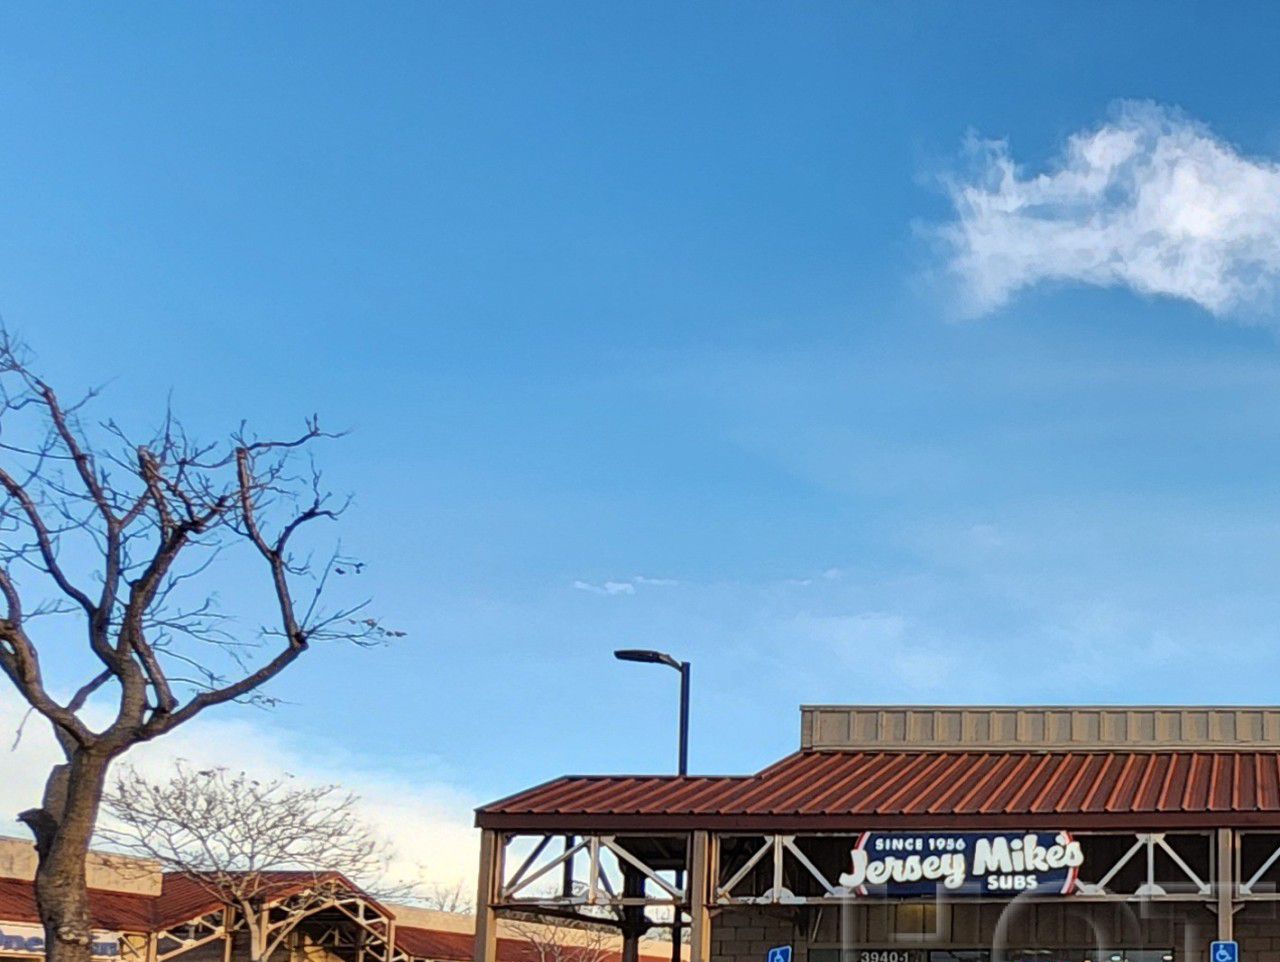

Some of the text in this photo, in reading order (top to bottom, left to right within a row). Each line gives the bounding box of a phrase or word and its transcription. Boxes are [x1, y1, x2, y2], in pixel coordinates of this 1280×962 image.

[874, 837, 966, 851] SINCE 1956
[838, 833, 1084, 890] Jersey Mike's
[987, 875, 1038, 890] SUBS
